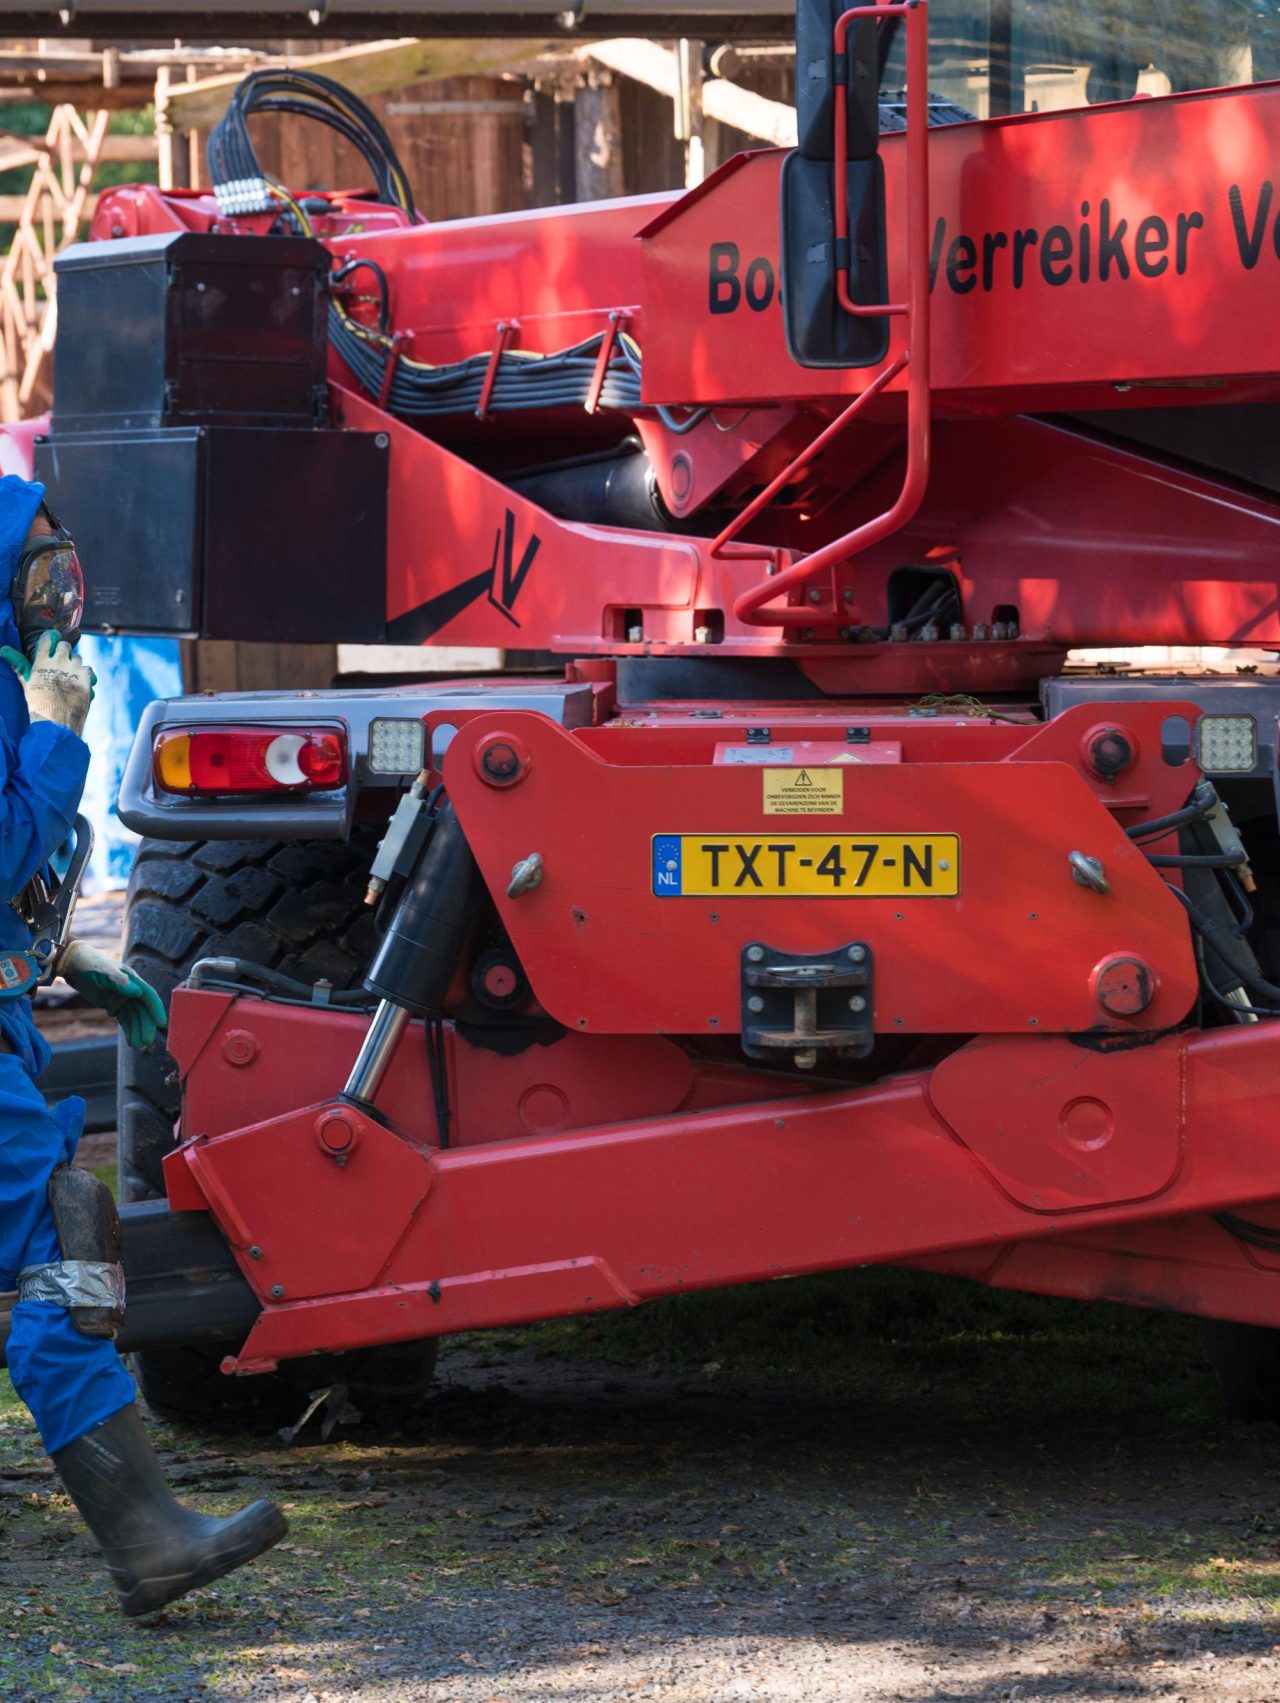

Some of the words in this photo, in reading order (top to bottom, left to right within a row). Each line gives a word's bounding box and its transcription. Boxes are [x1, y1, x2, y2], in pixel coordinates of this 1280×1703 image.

[709, 241, 782, 315] Bo
[1229, 180, 1280, 270] V
[658, 872, 678, 885] NL
[701, 845, 933, 887] TXT-47-N
